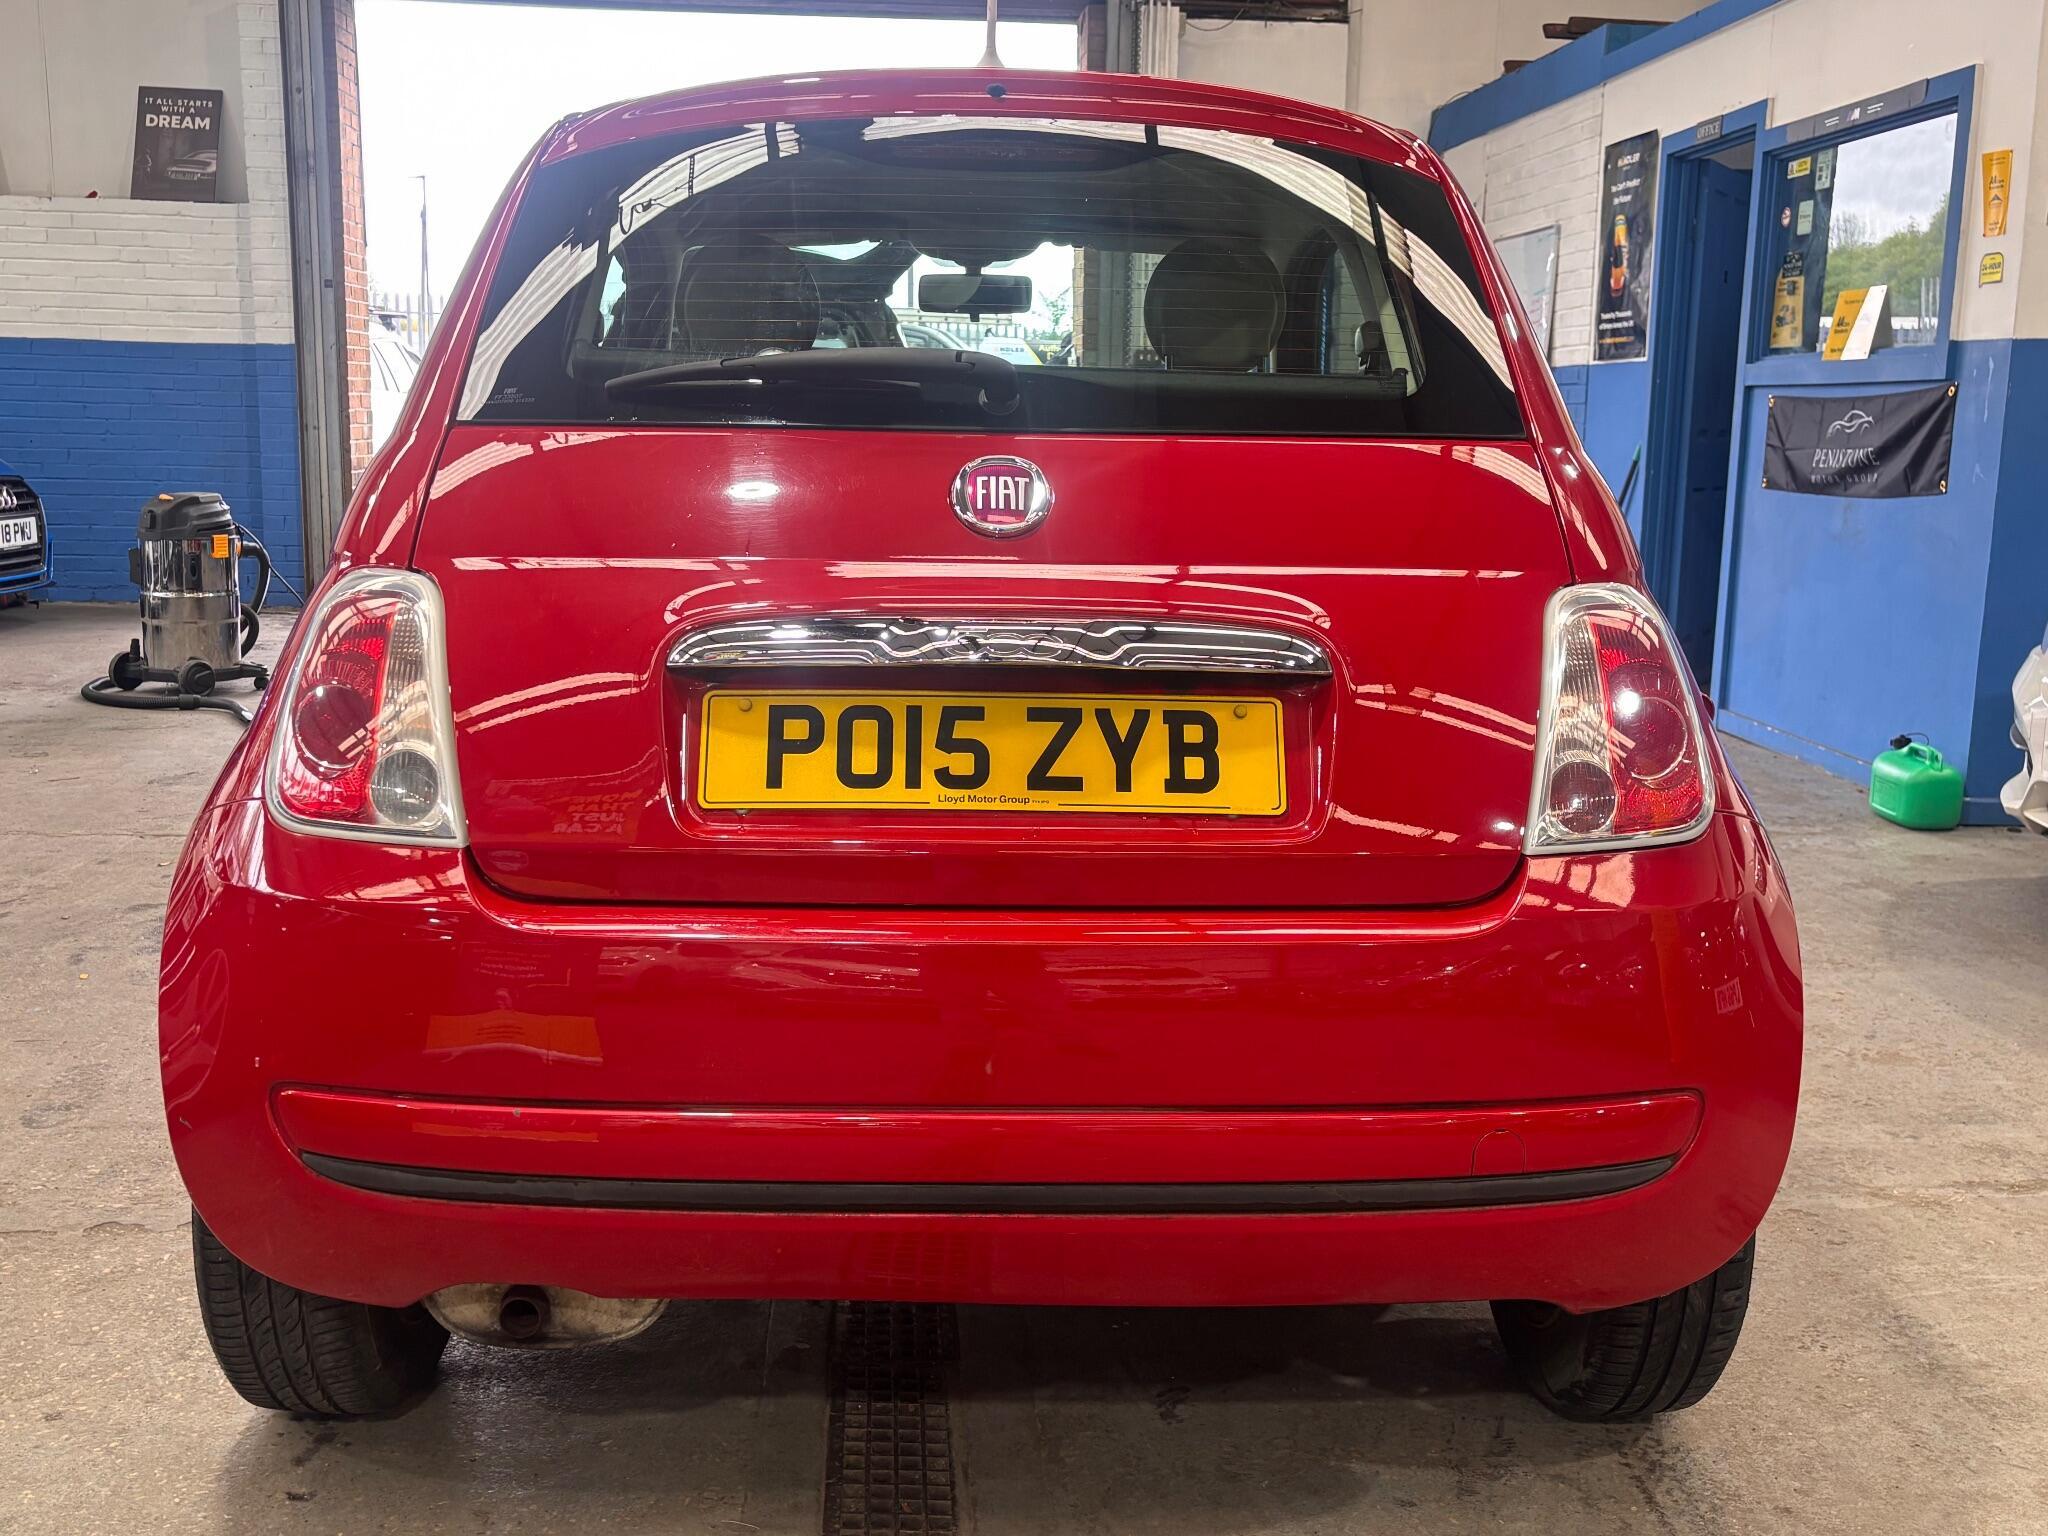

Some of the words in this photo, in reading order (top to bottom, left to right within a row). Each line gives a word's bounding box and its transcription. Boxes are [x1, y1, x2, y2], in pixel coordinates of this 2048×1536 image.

[161, 105, 185, 113] WITH
[177, 99, 213, 108] STARTS
[145, 113, 211, 130] DREAM
[1697, 121, 1720, 139] OFFICE
[976, 475, 1030, 511] FIAT
[766, 704, 990, 790] PO15
[1026, 706, 1220, 795] ZYB
[938, 794, 965, 804] Lloyd
[967, 795, 997, 804] Motor
[999, 795, 1030, 806] Group
